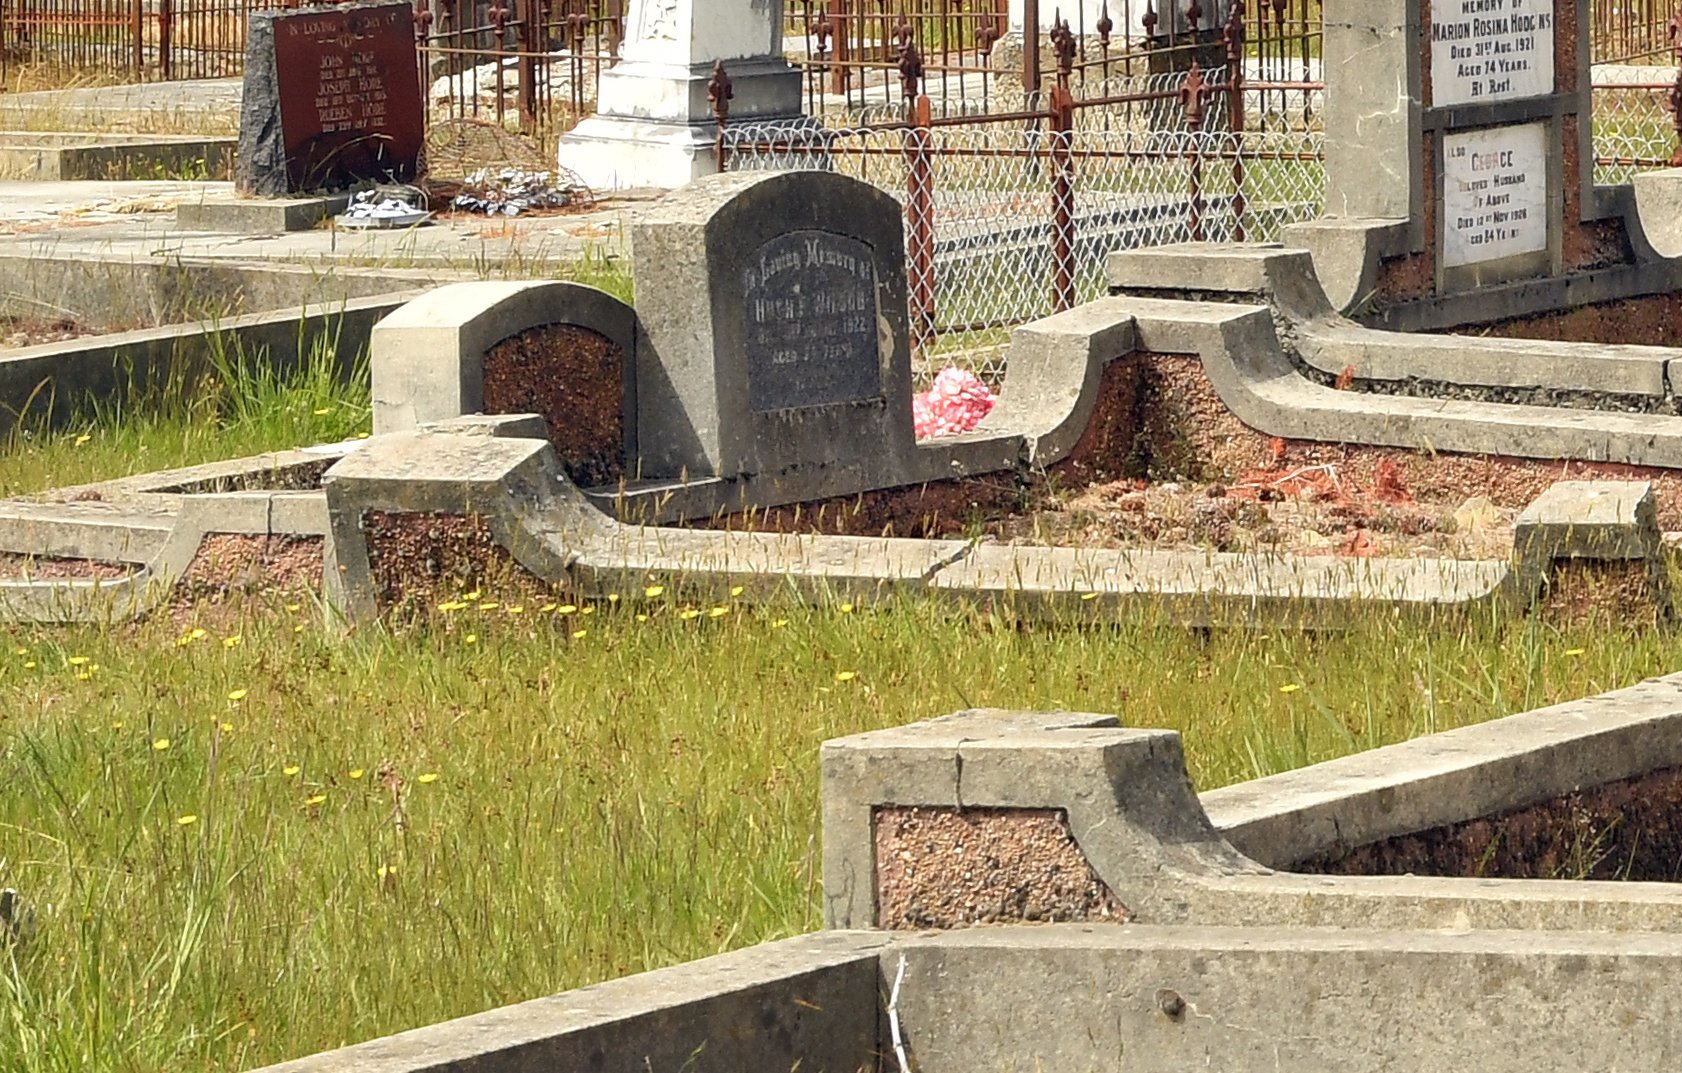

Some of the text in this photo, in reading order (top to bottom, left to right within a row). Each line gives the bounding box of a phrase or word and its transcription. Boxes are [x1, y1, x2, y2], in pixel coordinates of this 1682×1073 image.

[1432, 22, 1471, 42] MARION
[1473, 17, 1509, 38] ROSINA
[1457, 64, 1481, 78] AGED
[1472, 150, 1513, 171] GEORGE
[1493, 173, 1526, 188] HUSBAND
[1486, 193, 1510, 207] ABOVE
